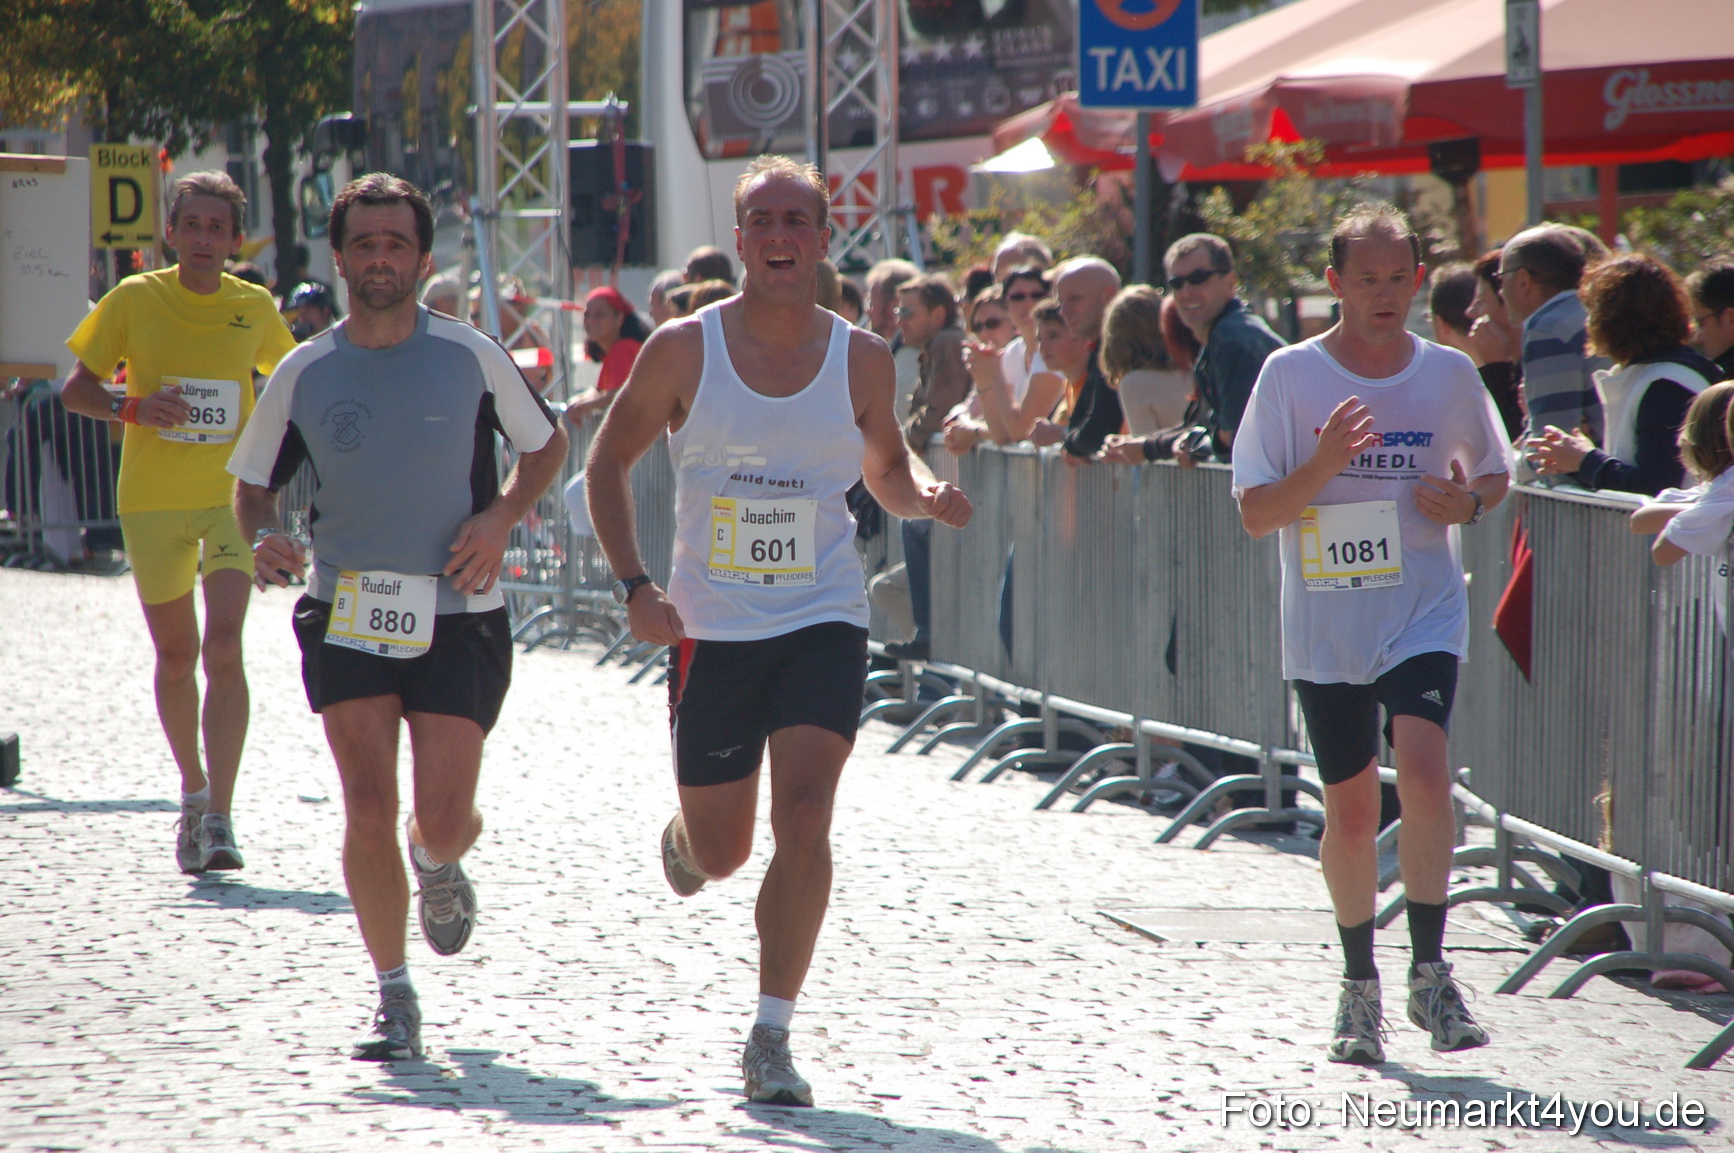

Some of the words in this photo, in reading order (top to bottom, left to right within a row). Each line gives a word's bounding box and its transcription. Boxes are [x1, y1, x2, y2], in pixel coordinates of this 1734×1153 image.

[1087, 46, 1187, 91] TAXI
[98, 148, 150, 168] Block
[109, 176, 143, 224] D
[182, 383, 218, 399] Jürgen
[189, 406, 226, 425] 963
[730, 473, 764, 485] wild
[741, 507, 796, 525] Joachim
[717, 528, 724, 541] C
[751, 537, 796, 562] 601
[1327, 537, 1389, 565] 1081
[775, 572, 814, 581] PFLEIDERER
[1362, 572, 1401, 583] PFLEIDERER
[361, 576, 402, 596] Rudolf
[338, 597, 345, 610] B
[369, 608, 416, 635] 880
[389, 643, 428, 654] PFLEIDERER
